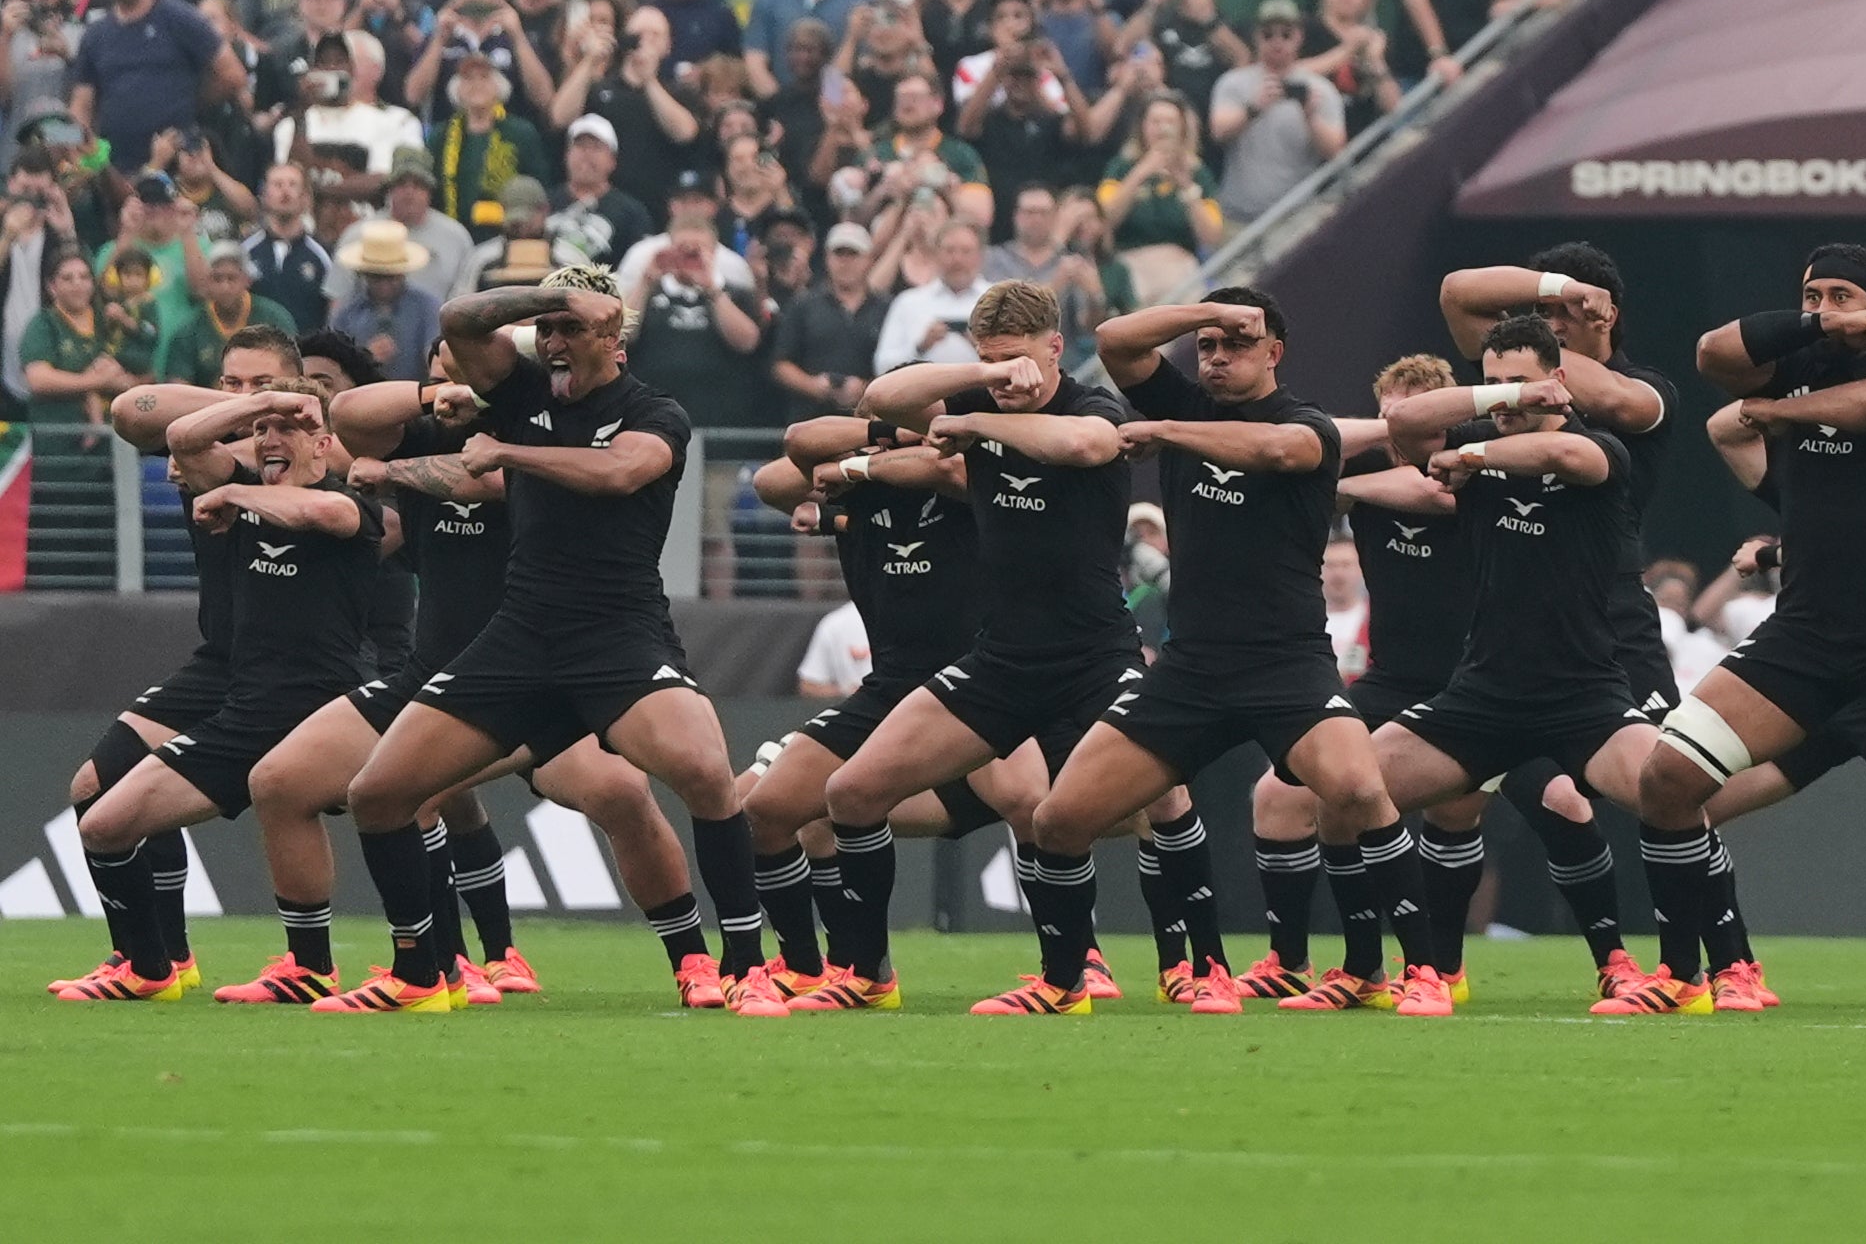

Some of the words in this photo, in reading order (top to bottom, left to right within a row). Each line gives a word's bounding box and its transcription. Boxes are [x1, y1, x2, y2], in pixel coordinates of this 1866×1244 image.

[1798, 439, 1853, 455] ALTRAD
[992, 492, 1046, 512] ALTRAD
[1191, 481, 1245, 505] ALTRAD
[434, 519, 485, 535] ALTRAD
[1496, 515, 1545, 536] ALTRAD
[248, 558, 298, 577] ALTRAD
